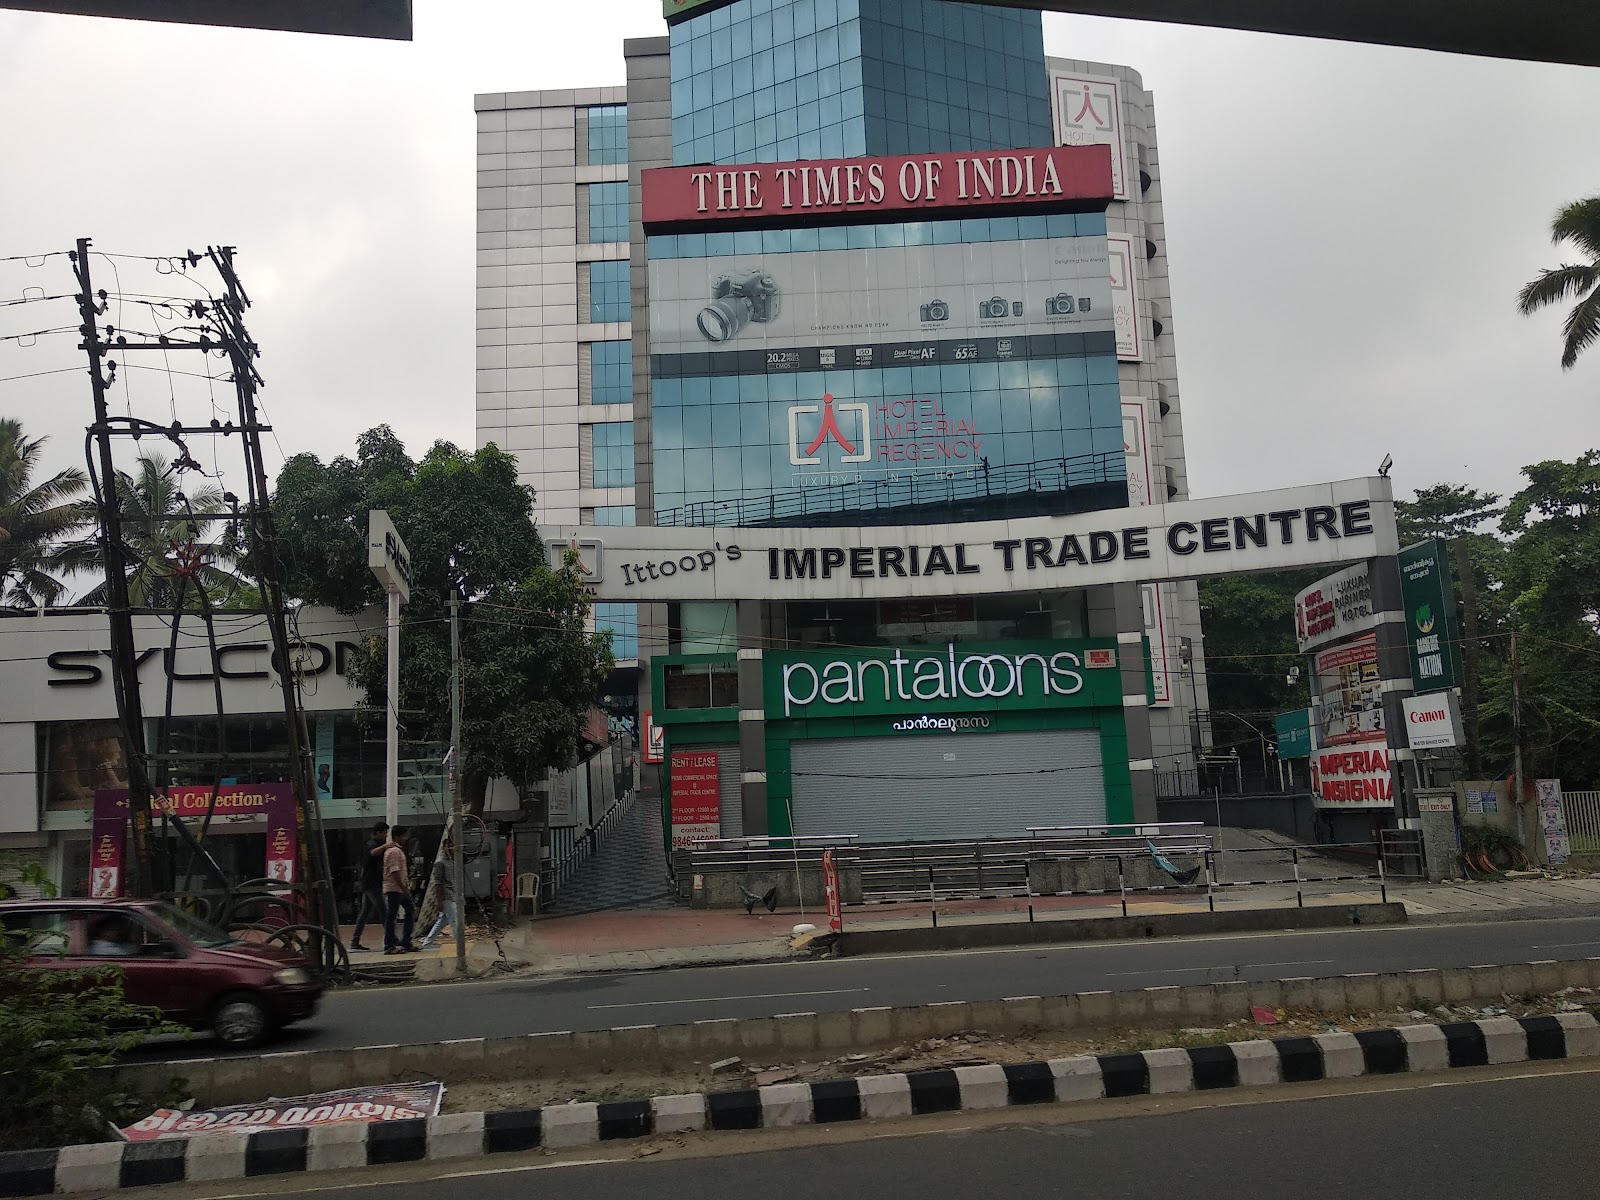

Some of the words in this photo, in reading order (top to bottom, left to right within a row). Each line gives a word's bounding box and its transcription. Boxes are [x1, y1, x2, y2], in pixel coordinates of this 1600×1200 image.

[691, 170, 764, 212] THE
[776, 163, 885, 208] TIMES
[899, 160, 943, 202] OF
[957, 153, 1064, 200] INDIA
[767, 353, 786, 363] 20.2
[920, 347, 936, 360] AF
[956, 348, 968, 360] 65
[874, 399, 946, 419] HOTEL
[875, 418, 983, 440] IMPERIAL
[877, 439, 984, 463] REGENCY
[791, 475, 848, 488] LUXURY
[620, 541, 742, 586] Ittoop's
[768, 544, 980, 581] IMPERIAL
[993, 526, 1152, 570] TRADE
[1168, 499, 1374, 556] CENTRE
[1336, 574, 1369, 593] LUXURY
[1334, 588, 1371, 608] BUSINES
[1341, 604, 1373, 622] HOTEL
[1418, 653, 1443, 677] NATION
[782, 643, 1084, 719] pantaloons
[1410, 709, 1446, 724] Canon
[671, 757, 690, 768] RENT
[694, 756, 716, 768] LEASE
[1430, 803, 1440, 811] EXIT
